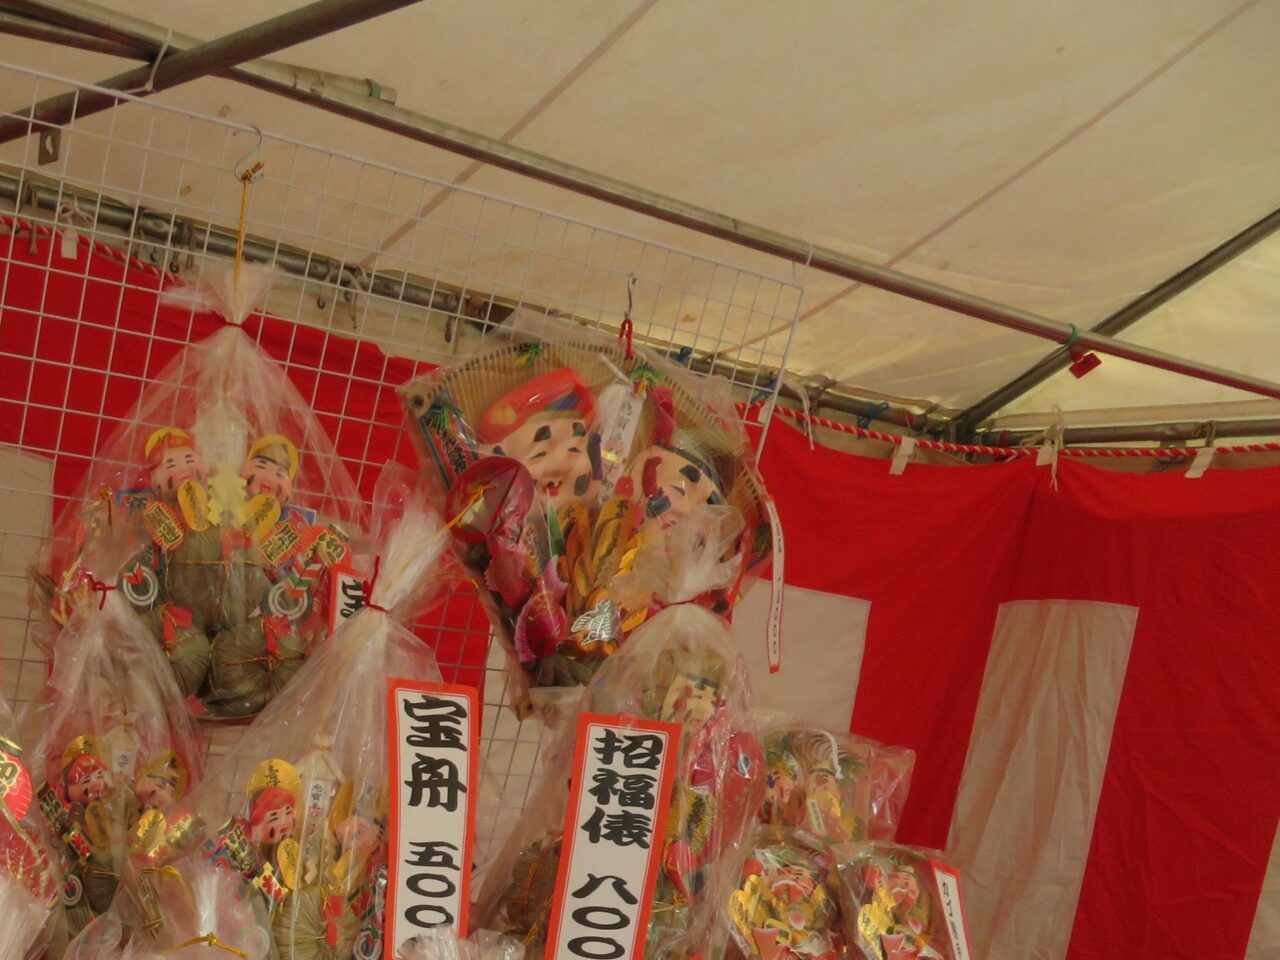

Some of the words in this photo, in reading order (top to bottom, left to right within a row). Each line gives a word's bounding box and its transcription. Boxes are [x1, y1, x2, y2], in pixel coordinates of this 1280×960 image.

[403, 696, 468, 812] 宝舟
[581, 728, 664, 849] 招福俵
